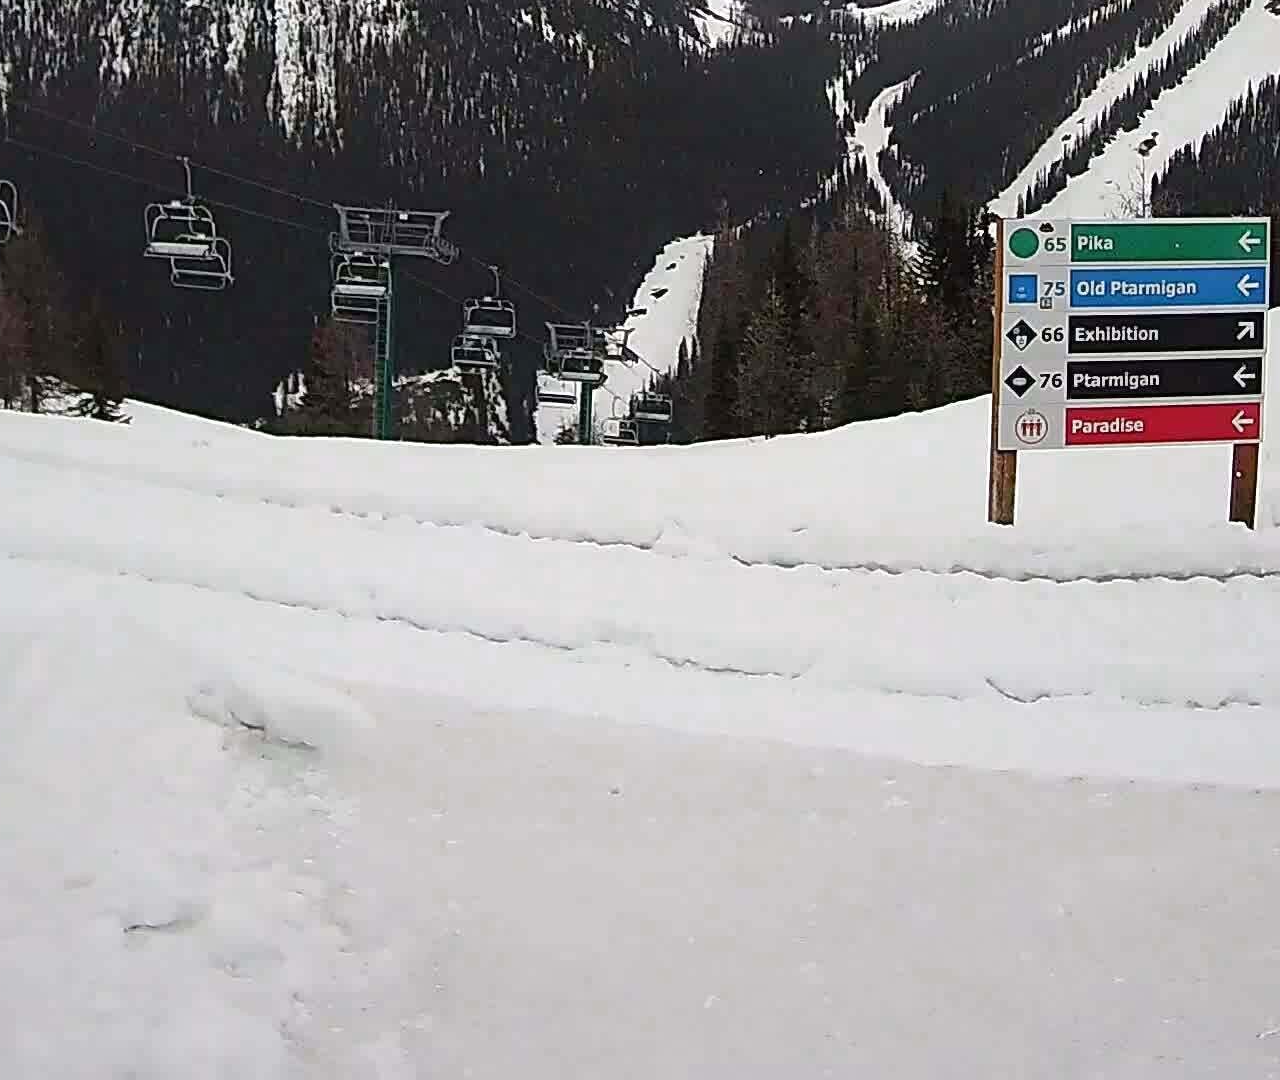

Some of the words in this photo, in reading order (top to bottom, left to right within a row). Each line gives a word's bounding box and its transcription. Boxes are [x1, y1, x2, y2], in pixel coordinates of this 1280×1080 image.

[1044, 237, 1067, 252] 65
[1077, 235, 1114, 251] Pika
[1043, 281, 1066, 298] 75
[1076, 280, 1105, 296] Old
[1110, 279, 1197, 300] Ptarmigan
[1041, 326, 1065, 343] 66
[1074, 325, 1159, 342] Exhibition
[1039, 373, 1063, 389] 76
[1073, 371, 1160, 393] Ptarmigan
[1071, 416, 1144, 434] Paradise
